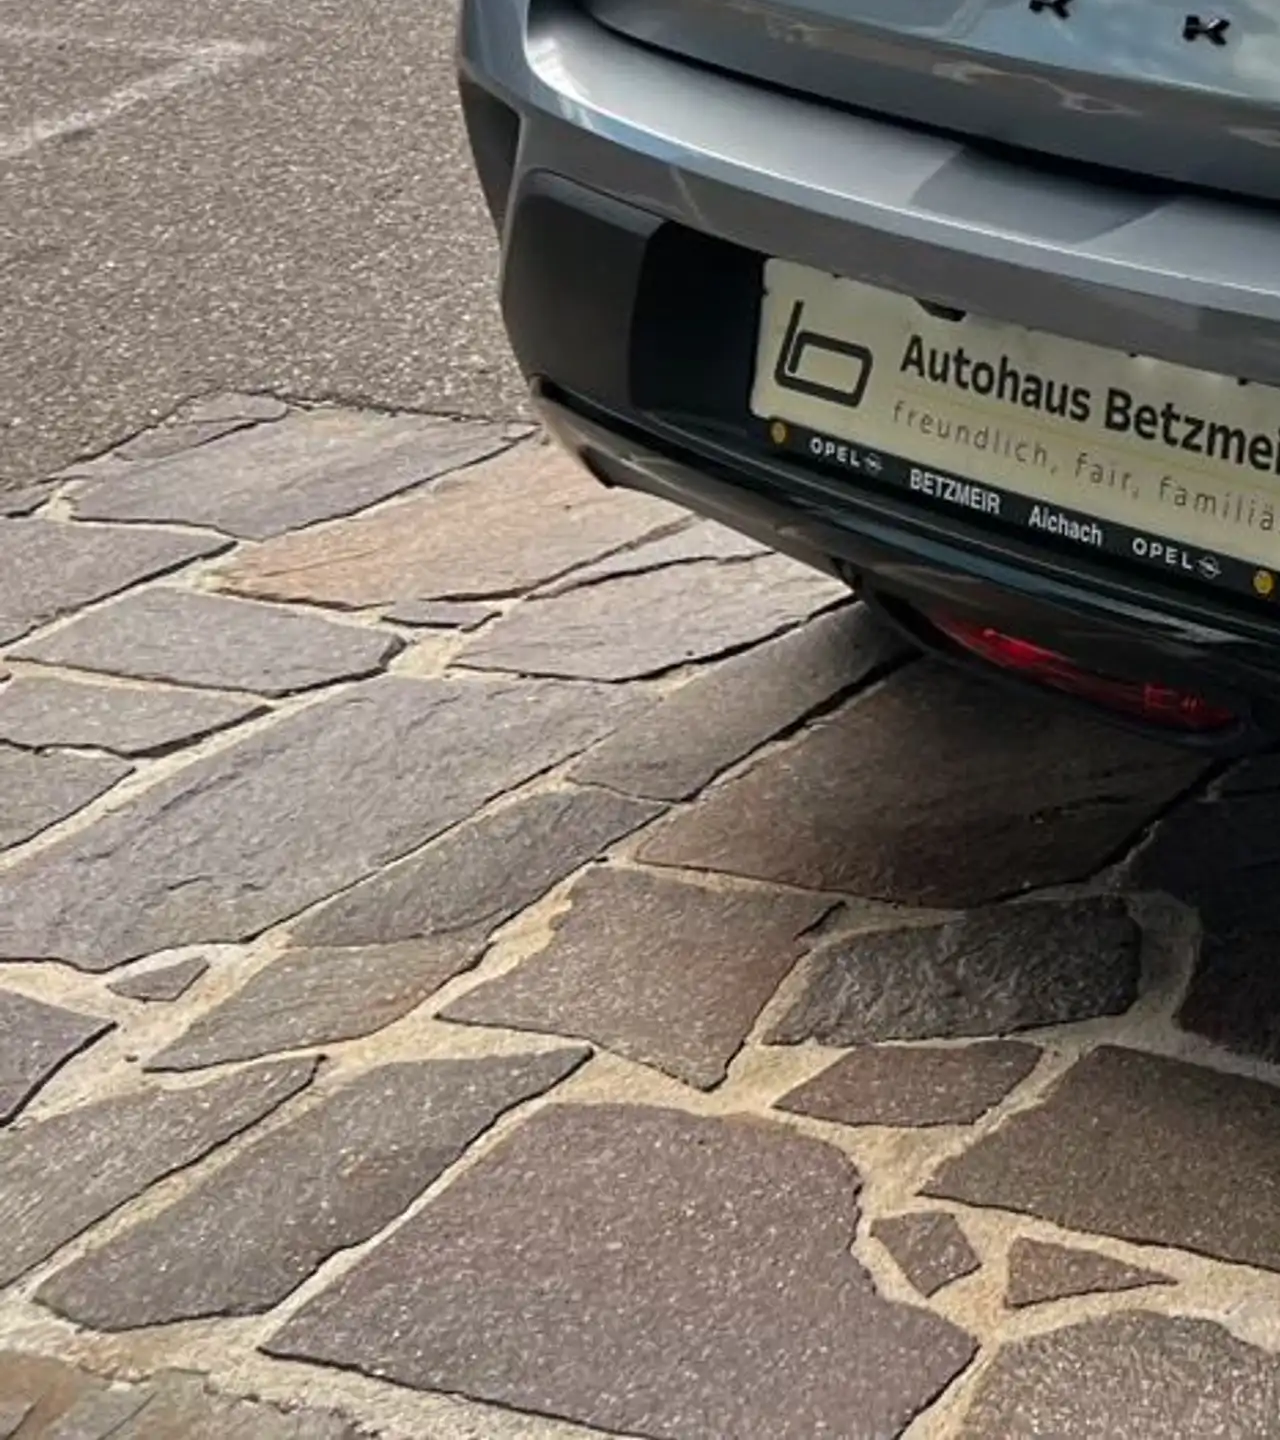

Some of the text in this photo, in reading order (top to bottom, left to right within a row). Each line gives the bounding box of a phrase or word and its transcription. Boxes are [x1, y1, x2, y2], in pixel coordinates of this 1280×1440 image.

[900, 334, 1091, 423] Autohaus
[892, 400, 1059, 476] freundlich,
[1074, 452, 1139, 499] fair,
[809, 437, 1194, 571] OPEL BETZMEIR Aichach OPEL
